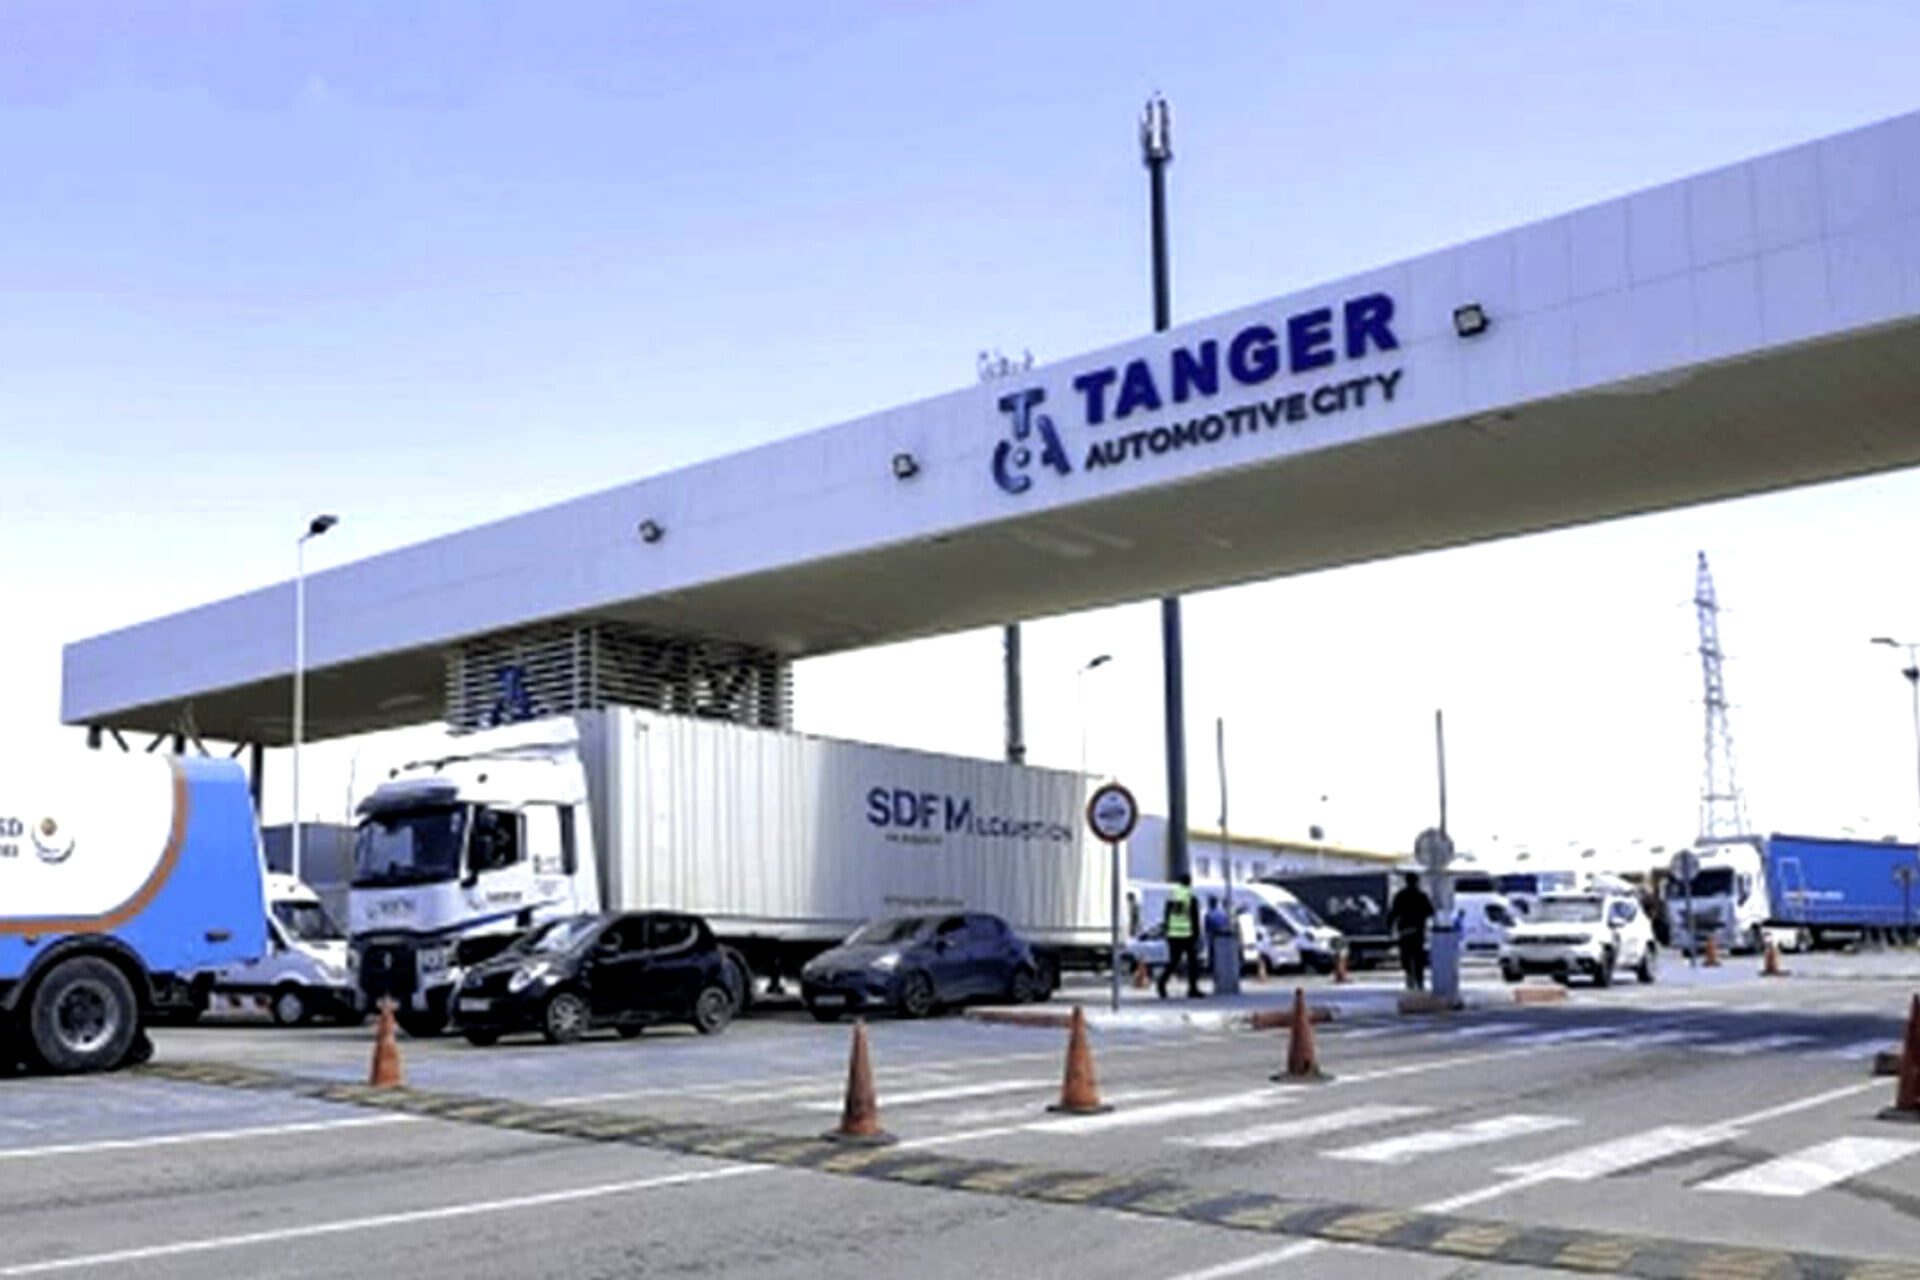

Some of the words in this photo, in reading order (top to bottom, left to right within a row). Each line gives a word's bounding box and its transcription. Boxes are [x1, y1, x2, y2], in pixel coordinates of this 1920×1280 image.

[1073, 292, 1399, 425] TANGER
[1085, 393, 1306, 471] AUTOMOTIVE
[1312, 369, 1403, 416] CITY
